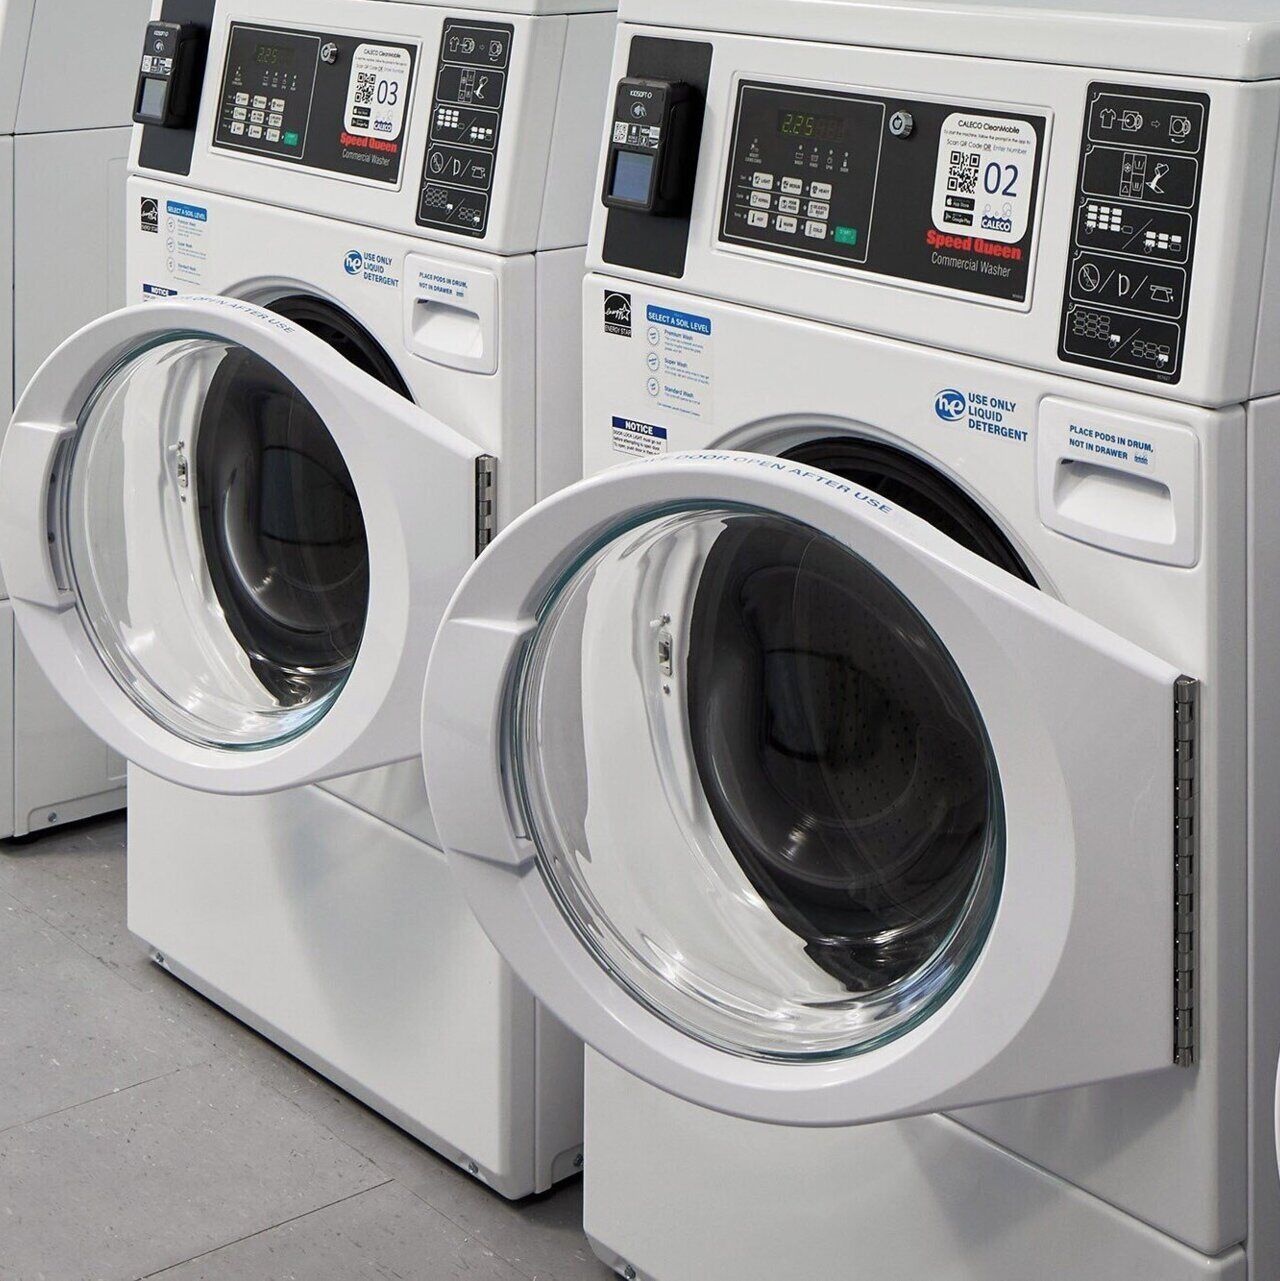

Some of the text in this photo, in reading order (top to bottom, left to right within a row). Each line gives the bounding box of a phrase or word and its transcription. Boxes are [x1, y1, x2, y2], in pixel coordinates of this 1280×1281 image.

[377, 80, 398, 105] 03
[782, 114, 814, 136] 2.25
[958, 120, 1020, 134] CALECO CleanMobile
[341, 132, 397, 153] Speed Queen
[984, 162, 1018, 197] 02
[927, 230, 1022, 260] Speed Queen
[364, 252, 392, 266] USE ONLY
[364, 262, 384, 274] LIQUID
[932, 251, 1011, 278] Commercial Washer
[364, 272, 399, 287] DETERGENT
[649, 312, 709, 333] SELECT A SOIL LEVEL
[969, 392, 1016, 413] USE ONLY
[969, 406, 1002, 422] LIQUID
[625, 421, 653, 435] NOTICE
[969, 419, 1027, 442] DETERGENT
[733, 458, 893, 514] OPEN AFTER USE
